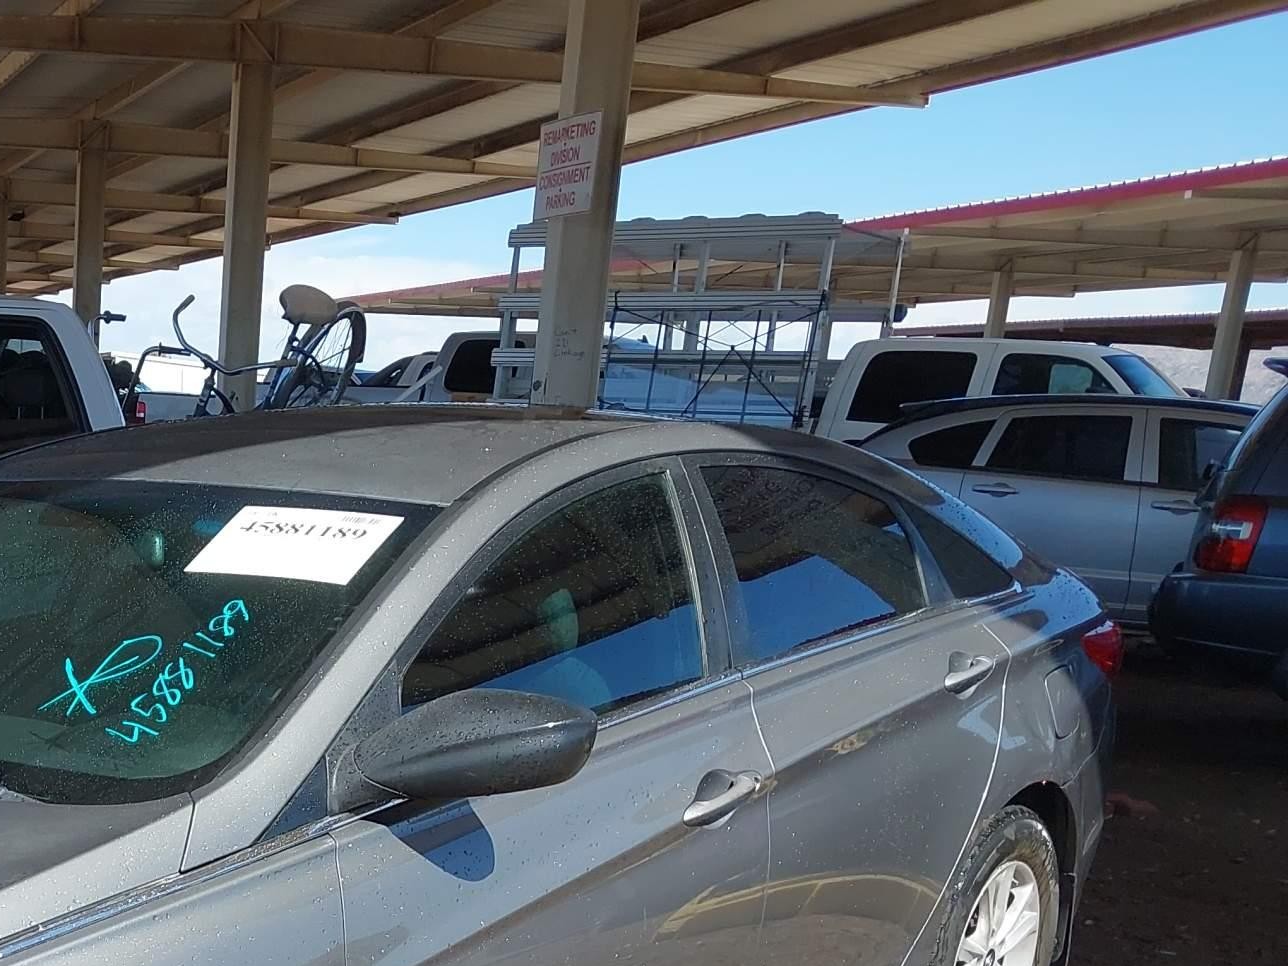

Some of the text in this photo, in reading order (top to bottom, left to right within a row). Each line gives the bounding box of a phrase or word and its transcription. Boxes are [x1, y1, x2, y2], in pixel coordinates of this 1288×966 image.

[543, 120, 596, 145] REMARKETING
[551, 144, 581, 166] DIVISION
[539, 166, 591, 190] CONSIGNMENT
[546, 191, 576, 212] PARKING
[240, 520, 368, 540] 45881189
[105, 599, 250, 743] 45881189
